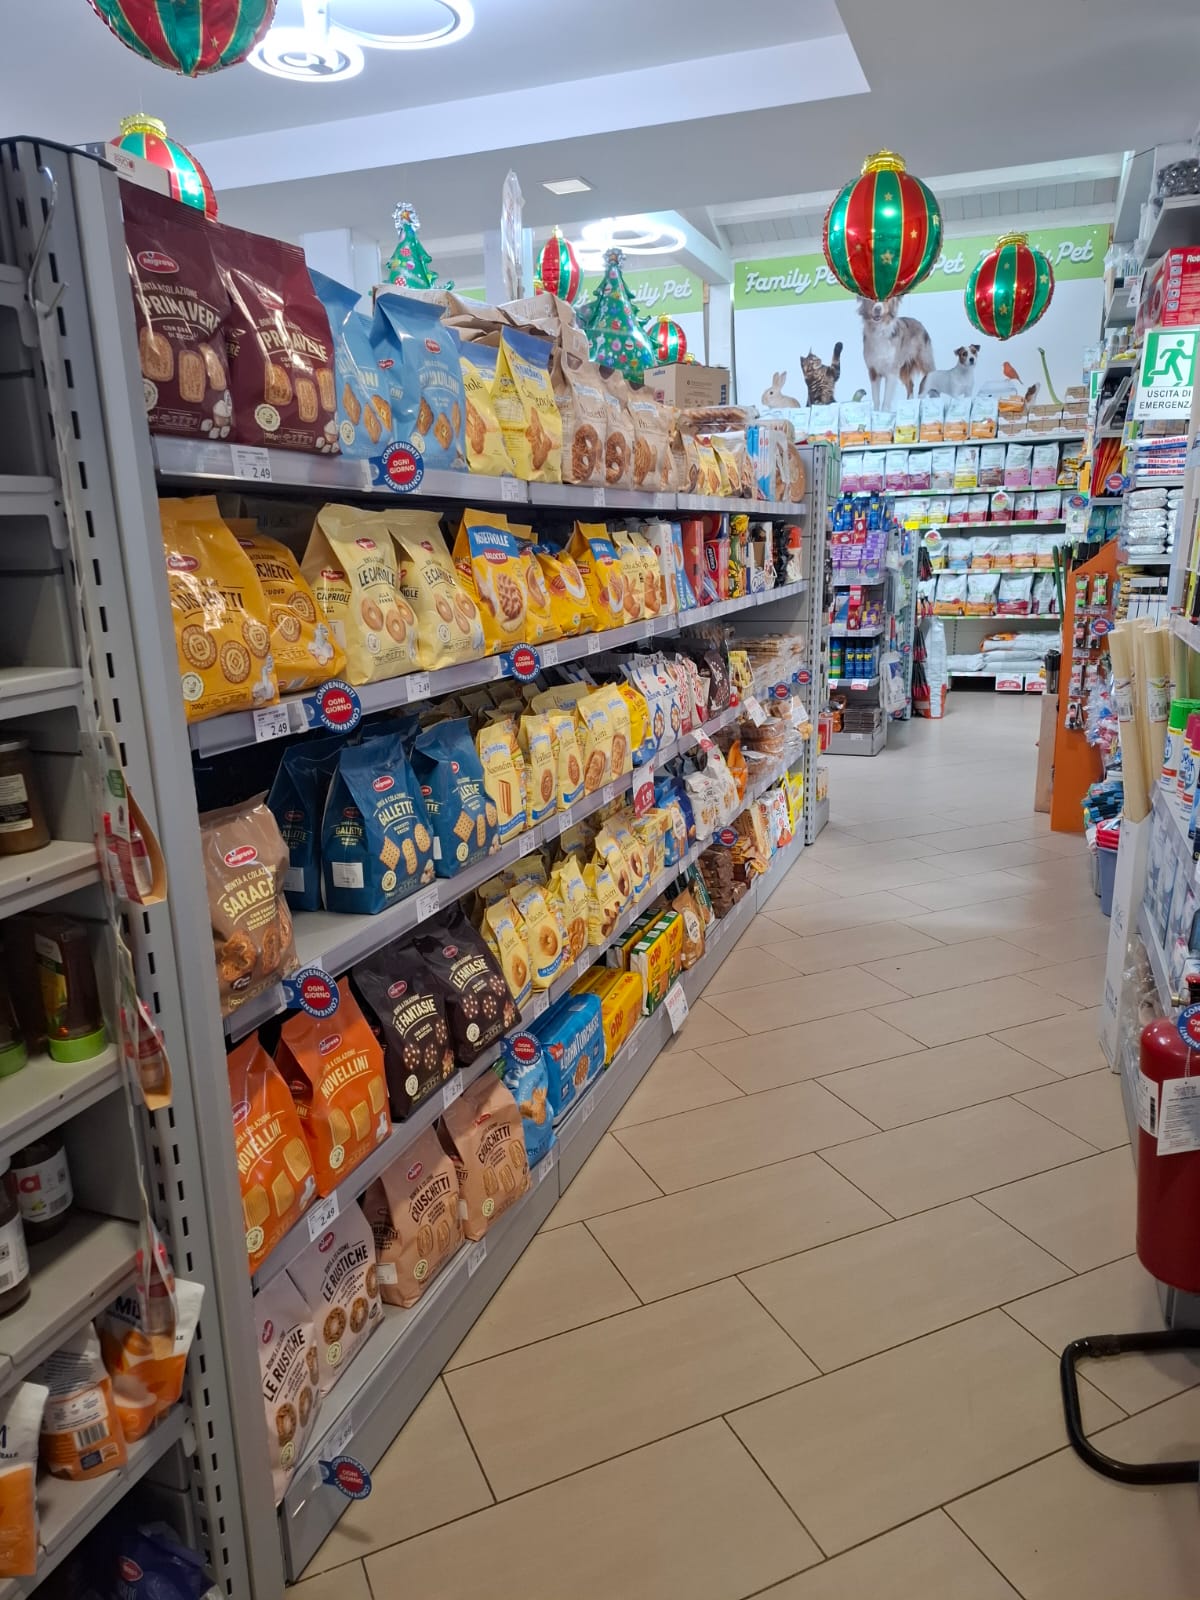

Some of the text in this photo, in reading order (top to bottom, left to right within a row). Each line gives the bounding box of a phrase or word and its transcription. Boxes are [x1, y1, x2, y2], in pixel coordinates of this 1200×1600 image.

[1057, 239, 1094, 263] Pet
[662, 279, 692, 300] Pet
[745, 265, 843, 295] Family Pe
[1147, 388, 1191, 399] USCITA DI
[382, 441, 420, 465] CONVENIENTI
[392, 458, 410, 467] OGNI
[383, 469, 423, 492] CONVENIENTI
[389, 464, 415, 474] GIORNO
[358, 569, 369, 587] LE
[315, 681, 355, 705] CONVENIENTI
[328, 697, 346, 706] OGNI
[320, 706, 360, 731] CONVENIENTI
[325, 703, 353, 714] GIORNO
[271, 722, 288, 736] 2.49
[378, 800, 415, 828] GALLETTE
[295, 967, 335, 988] CONVENIENTI
[304, 990, 331, 999] GIORNO
[299, 997, 339, 1018] CONVENIENTI
[399, 998, 437, 1028] FANTASIE
[610, 1011, 624, 1038] ORO
[320, 1055, 369, 1100] NOVELLINI
[411, 1175, 451, 1224] CRUSCHETTI
[320, 1207, 336, 1227] 2.49
[323, 1281, 335, 1303] LE
[329, 1244, 369, 1289] RUSTICHE
[263, 1379, 278, 1402] LE
